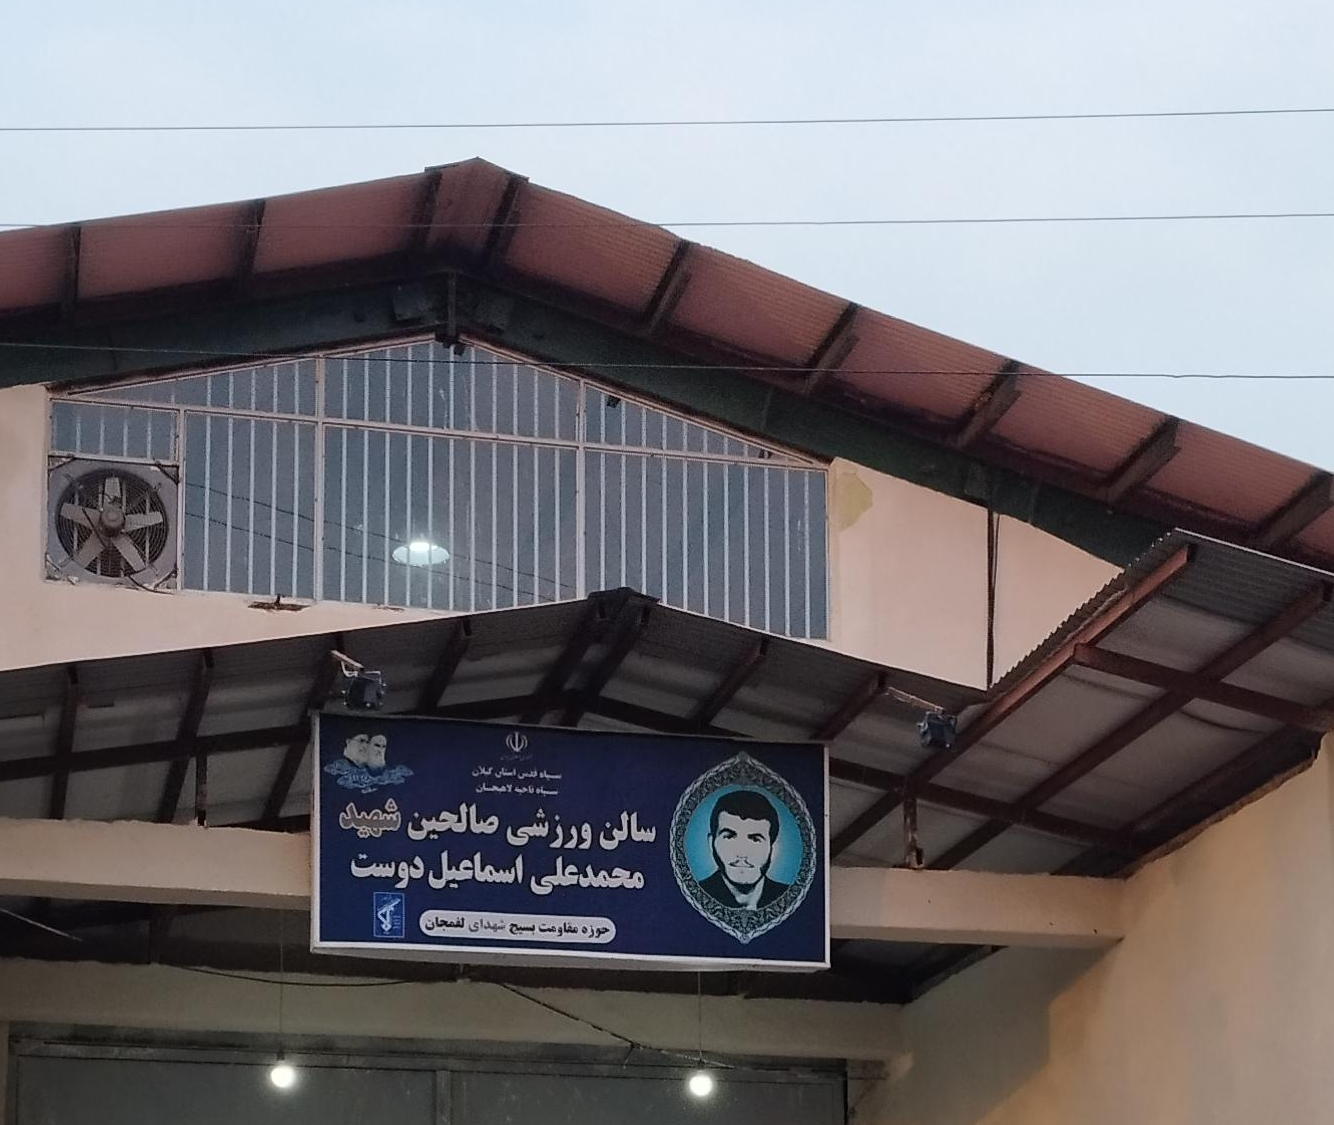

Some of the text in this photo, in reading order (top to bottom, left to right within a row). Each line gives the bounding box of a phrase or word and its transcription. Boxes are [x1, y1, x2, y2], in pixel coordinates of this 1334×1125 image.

[471, 765, 562, 780] سپاه قدس استان گیلان
[475, 781, 559, 797] سپاه ناحیه لاهیجان
[338, 797, 657, 850] سالن ورزشی صالحین شهید
[350, 849, 646, 895] محمدعلی اسماعیل دوست
[424, 915, 611, 939] حوزه مقاومت بسیج شهدای لفمجان
